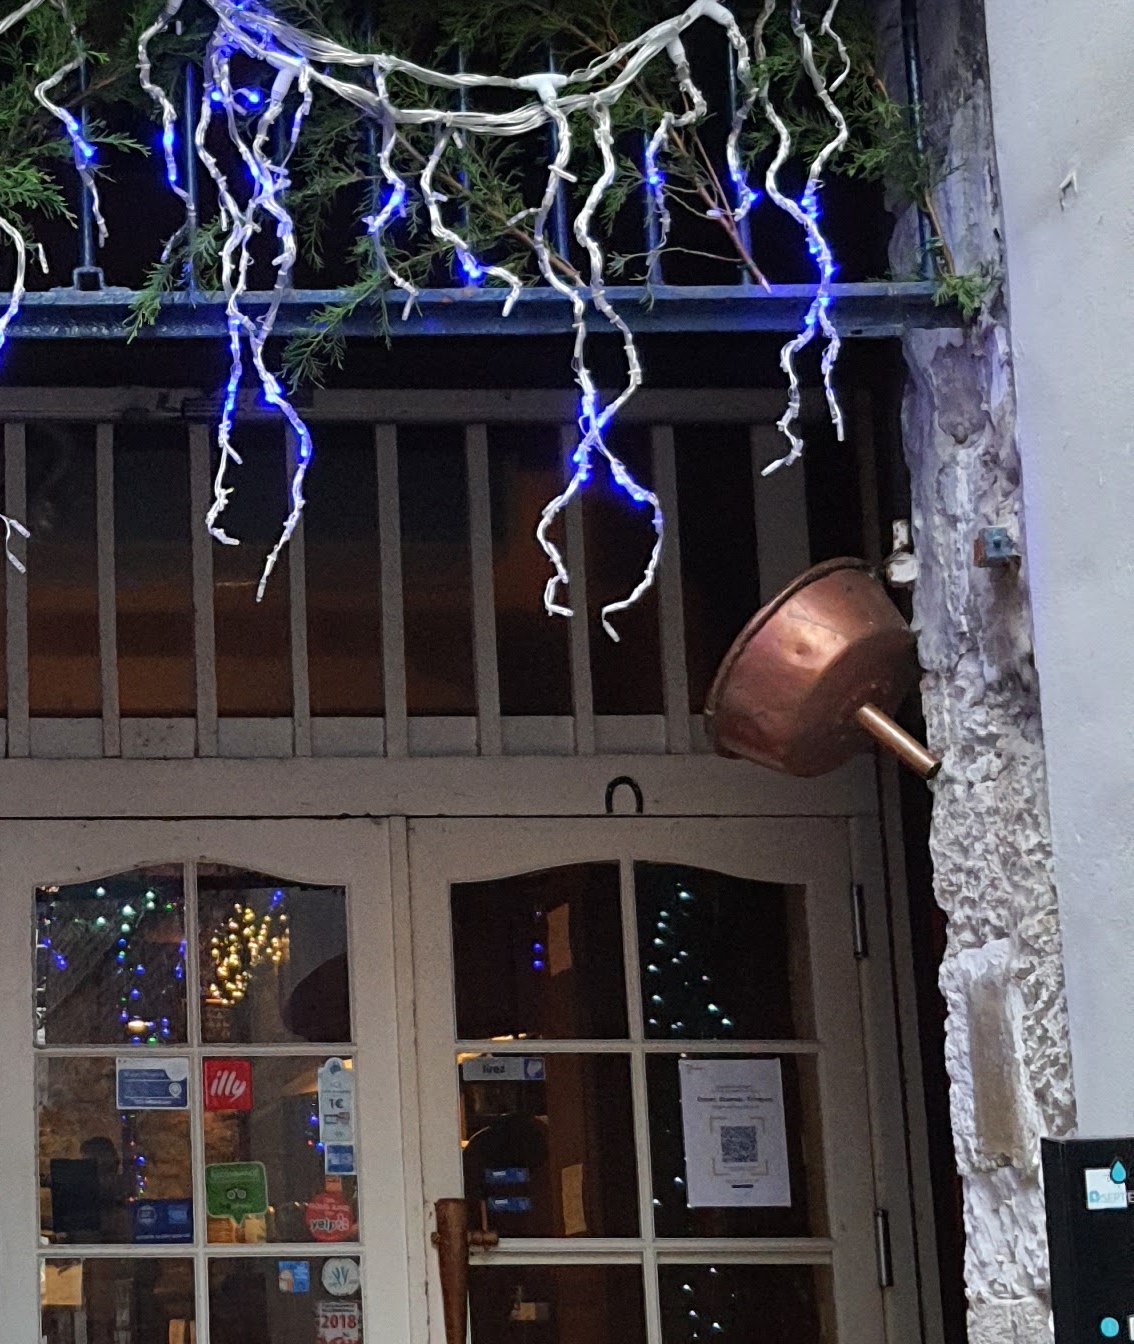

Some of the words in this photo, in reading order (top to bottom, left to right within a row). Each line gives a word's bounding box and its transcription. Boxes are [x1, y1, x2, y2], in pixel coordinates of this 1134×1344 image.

[210, 1069, 247, 1103] illy
[329, 1097, 345, 1109] 1€
[310, 1217, 337, 1233] yelp
[321, 1314, 357, 1329] 2018
